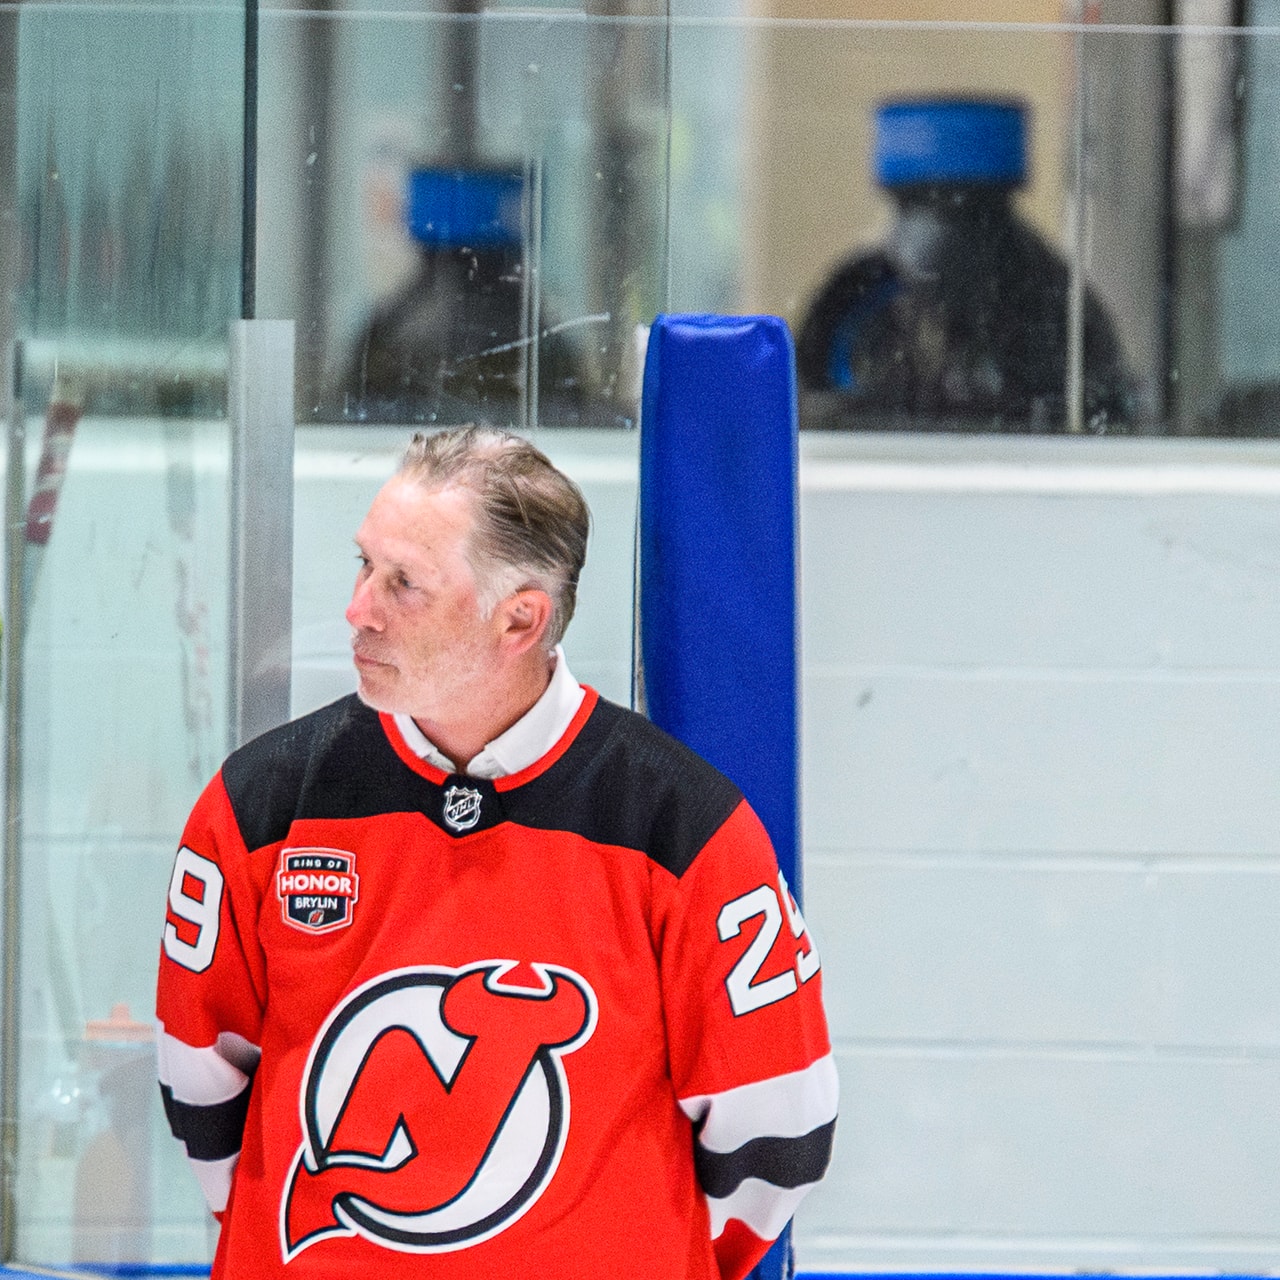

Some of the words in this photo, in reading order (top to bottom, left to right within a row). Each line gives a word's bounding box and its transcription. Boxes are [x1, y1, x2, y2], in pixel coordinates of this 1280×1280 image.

[293, 859, 322, 868] RING
[281, 874, 352, 894] HONOR
[163, 844, 225, 974] 9
[295, 896, 338, 910] BRYLIN
